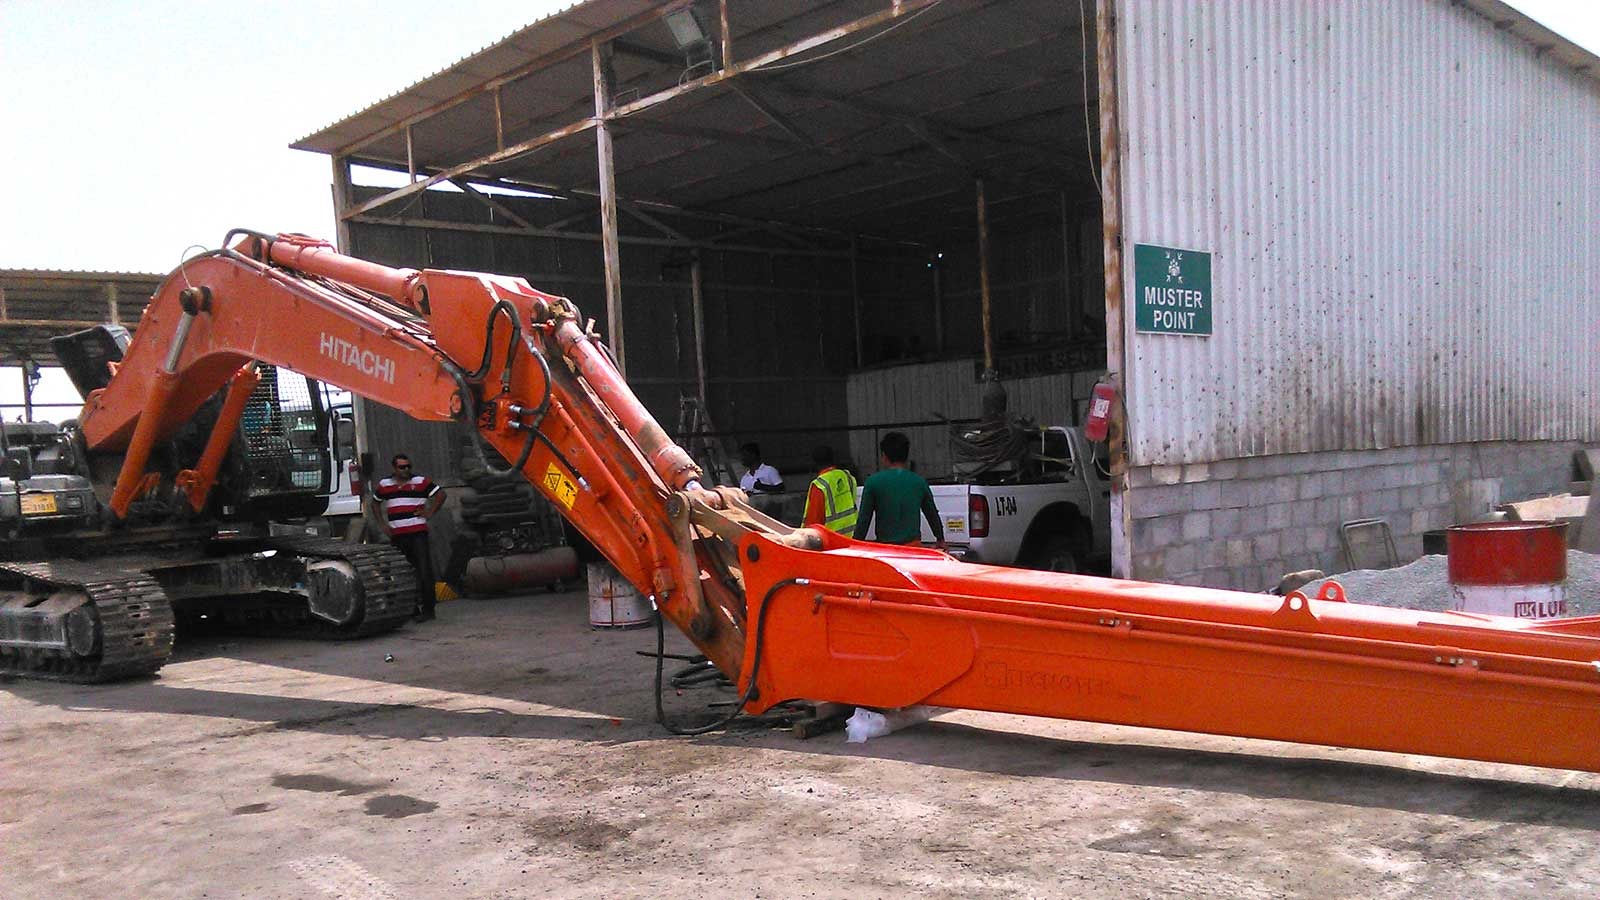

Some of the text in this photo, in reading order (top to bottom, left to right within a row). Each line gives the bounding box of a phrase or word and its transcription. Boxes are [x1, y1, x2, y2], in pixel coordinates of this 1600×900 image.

[1144, 286, 1203, 308] MUSTER
[1153, 310, 1195, 330] POINT
[320, 331, 396, 385] HITACHI
